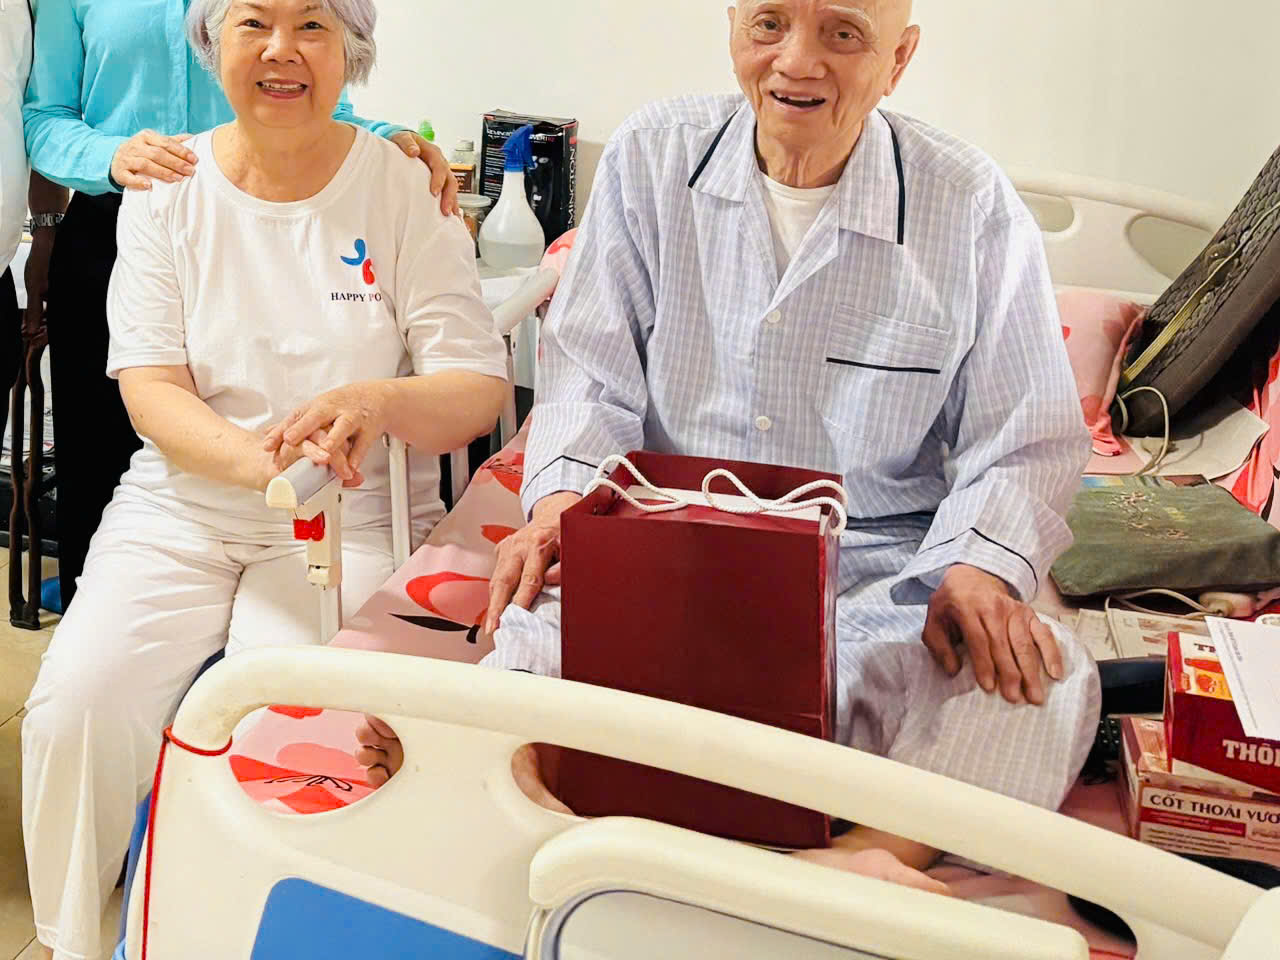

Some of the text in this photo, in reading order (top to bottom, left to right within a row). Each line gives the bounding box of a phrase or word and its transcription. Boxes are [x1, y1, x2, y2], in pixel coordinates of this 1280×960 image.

[567, 146, 577, 229] MINGTON
[331, 292, 366, 302] HAPPY
[1149, 792, 1185, 810] CỐT
